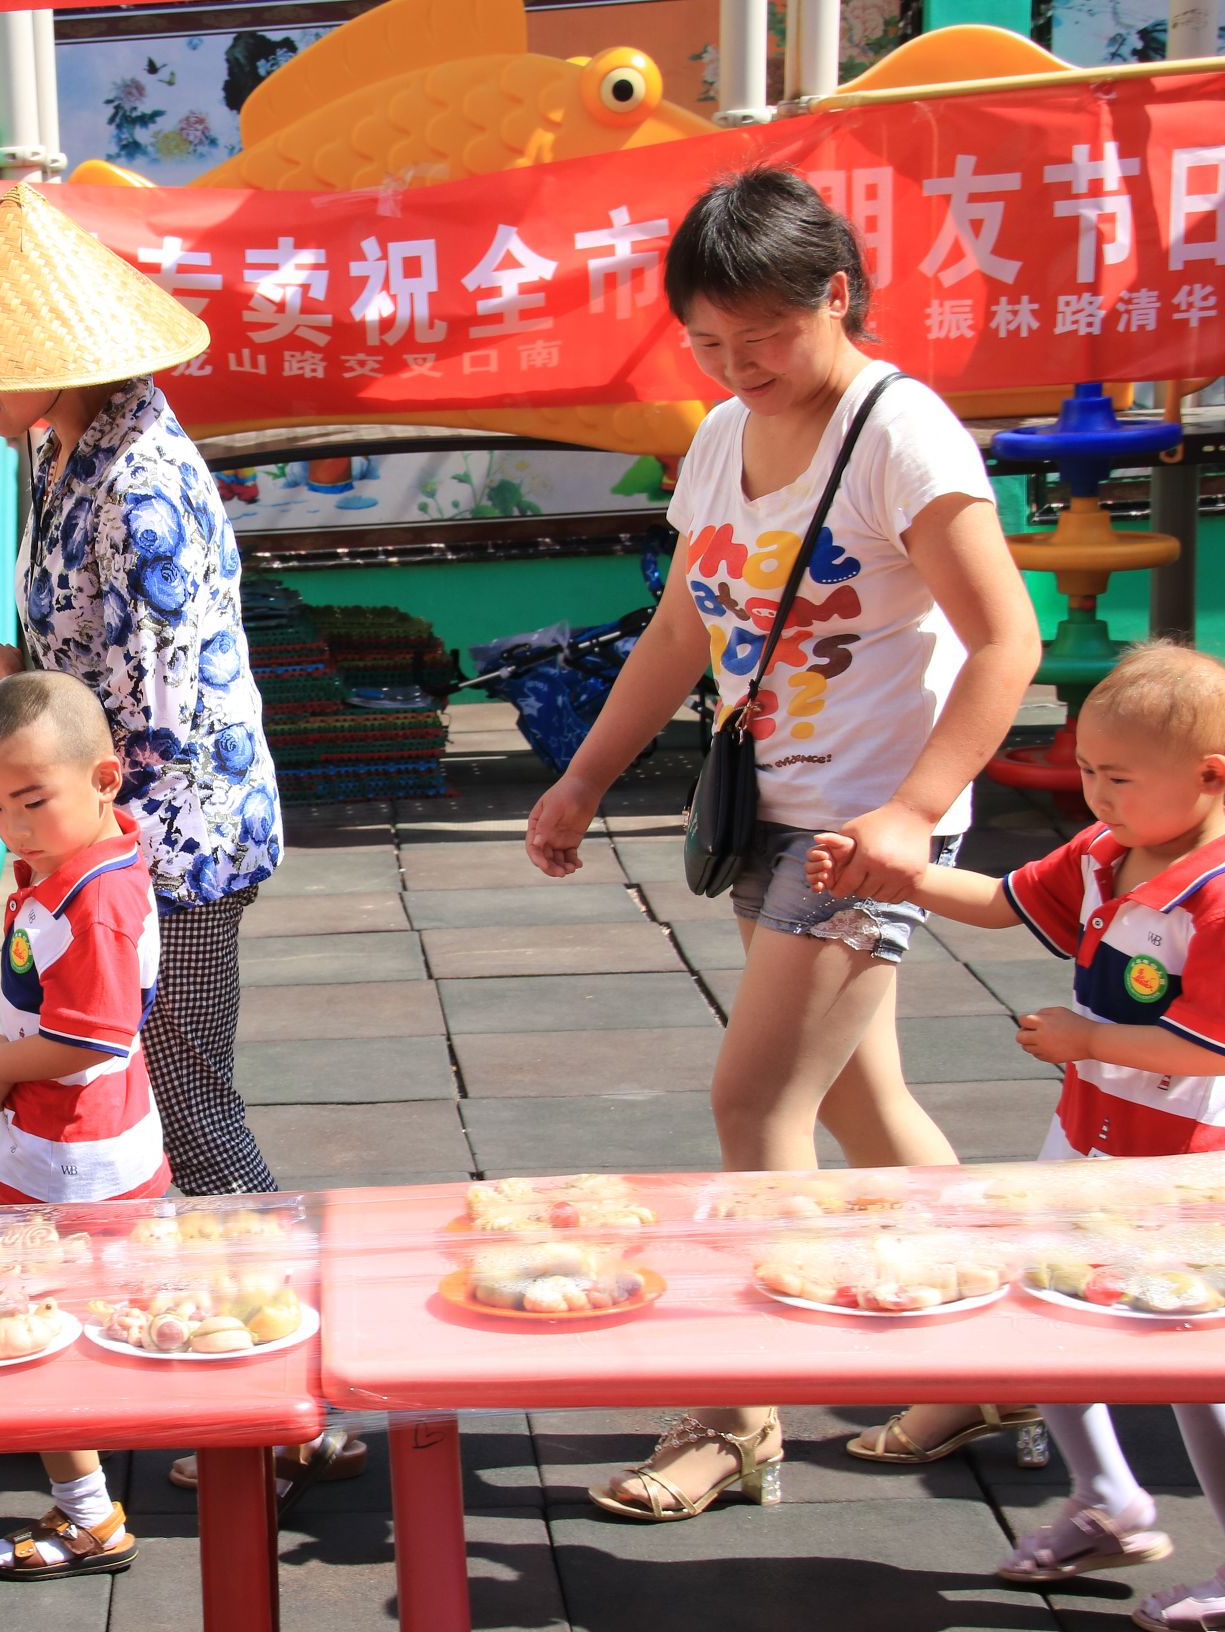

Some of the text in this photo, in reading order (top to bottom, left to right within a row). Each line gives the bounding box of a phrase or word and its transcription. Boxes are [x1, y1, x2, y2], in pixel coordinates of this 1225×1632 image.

[925, 283, 1217, 340] 振林路清华
